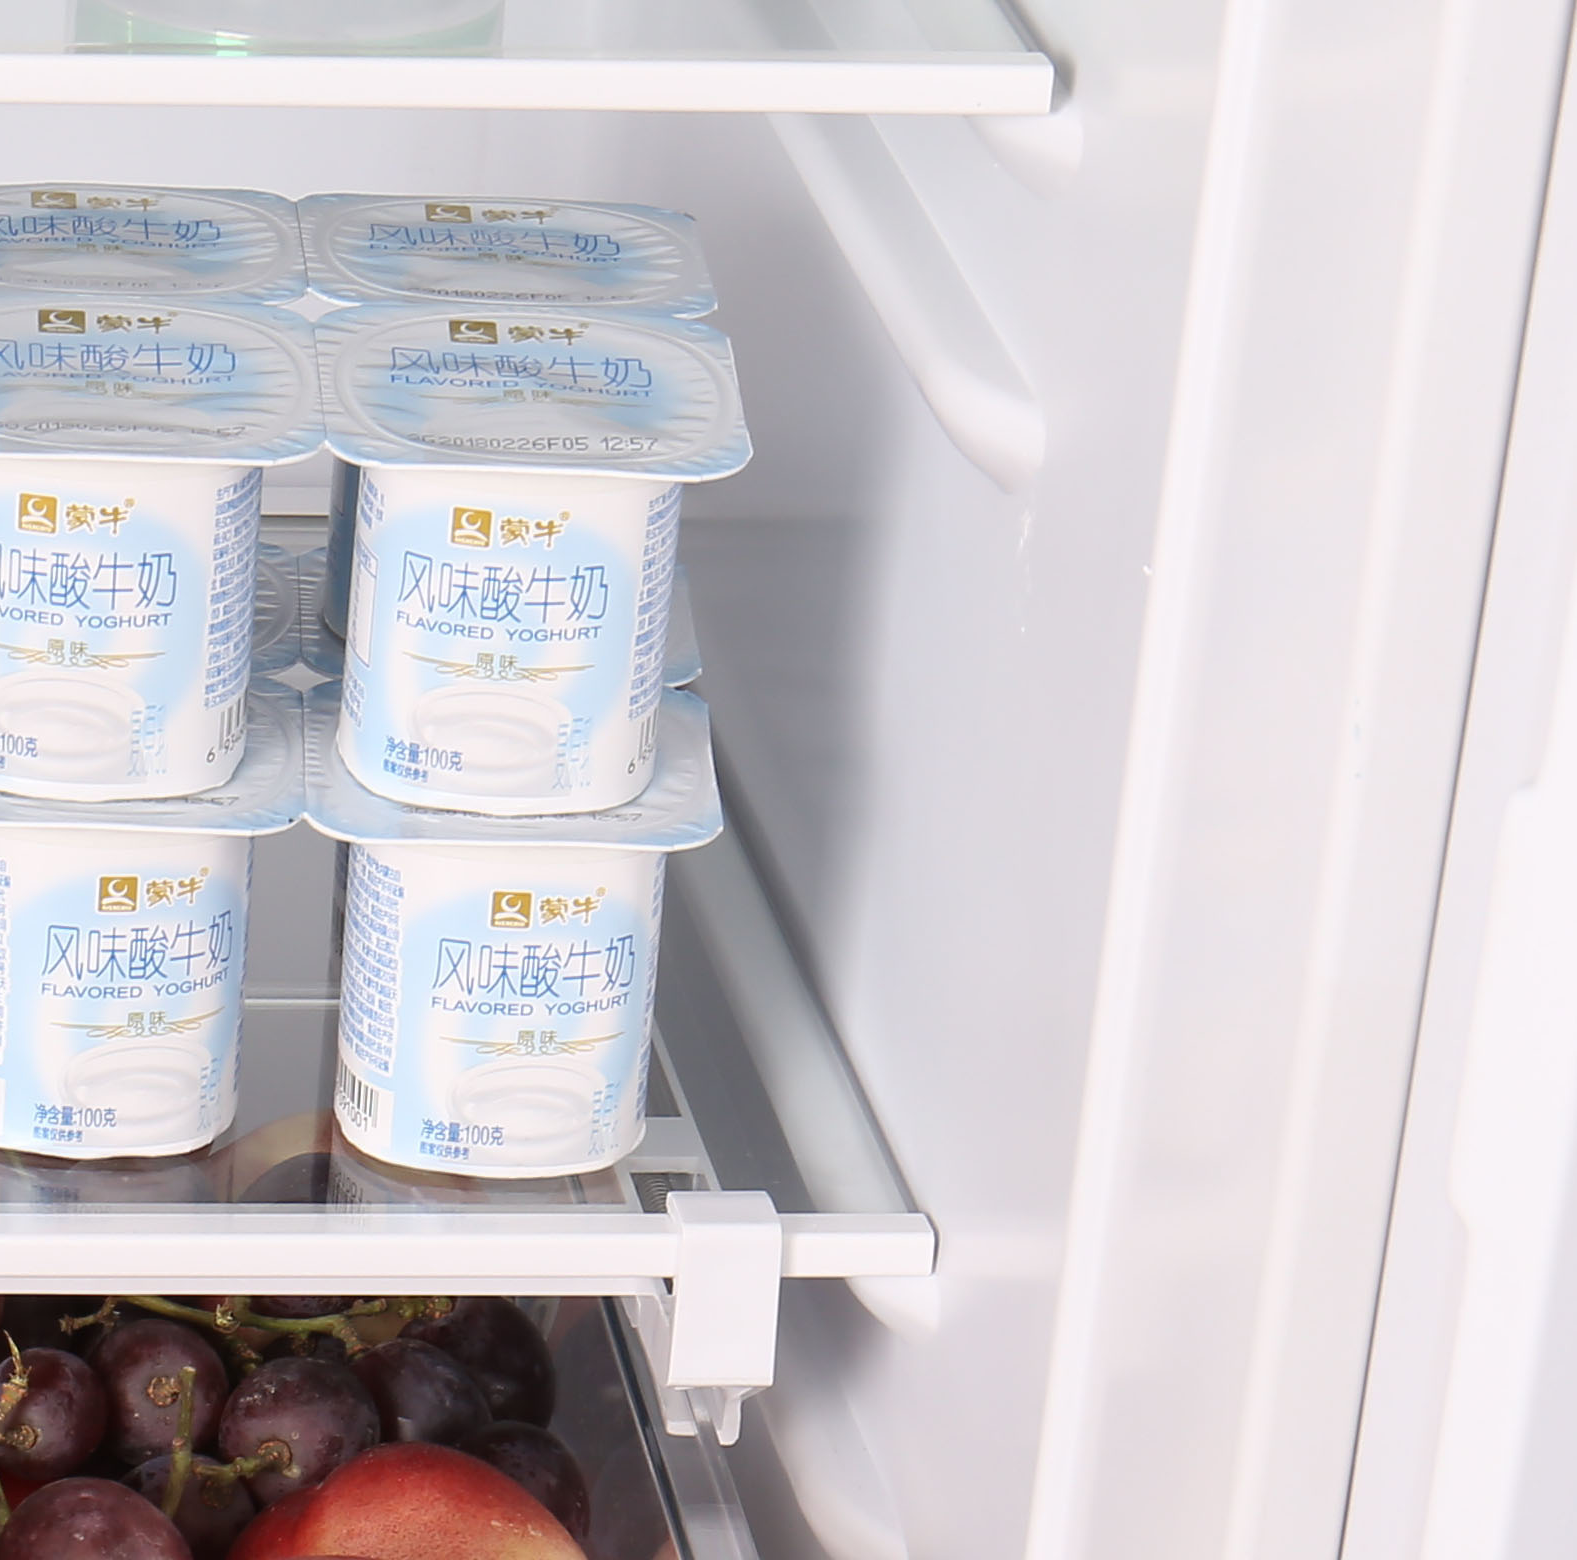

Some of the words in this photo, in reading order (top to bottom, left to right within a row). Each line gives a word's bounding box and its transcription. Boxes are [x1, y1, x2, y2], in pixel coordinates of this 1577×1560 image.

[369, 223, 621, 257] 风味酸牛奶
[96, 313, 172, 335] 蒙牛
[508, 325, 585, 346] 蒙牛
[390, 346, 652, 388] 风味酸牛奶
[390, 374, 520, 389] FLAVORED
[533, 381, 654, 398] YOGHURT
[600, 437, 659, 452] 12:57
[64, 503, 128, 534] 蒙牛
[500, 517, 563, 547] 蒙牛
[398, 551, 609, 622] 风味酸牛奶
[76, 613, 174, 630] YOGHURT
[397, 612, 494, 640] FLAVORED
[505, 626, 602, 642] YOGHURT
[47, 638, 88, 658] 原味
[476, 652, 520, 672] 原味
[146, 879, 204, 906] 蒙牛
[539, 898, 601, 924] 蒙牛
[42, 911, 233, 981] 风味酸牛奶
[432, 934, 635, 999] 风味酸牛奶
[41, 983, 142, 999] FLAVORED
[153, 967, 229, 997] YOGHURT
[432, 997, 534, 1016] FLAVORED
[545, 992, 630, 1016] YOGHURT
[127, 1011, 167, 1029] 原味
[518, 1031, 558, 1046] 原味
[34, 1103, 117, 1128] 净含量:100克
[421, 1119, 504, 1146] 净含量:100克
